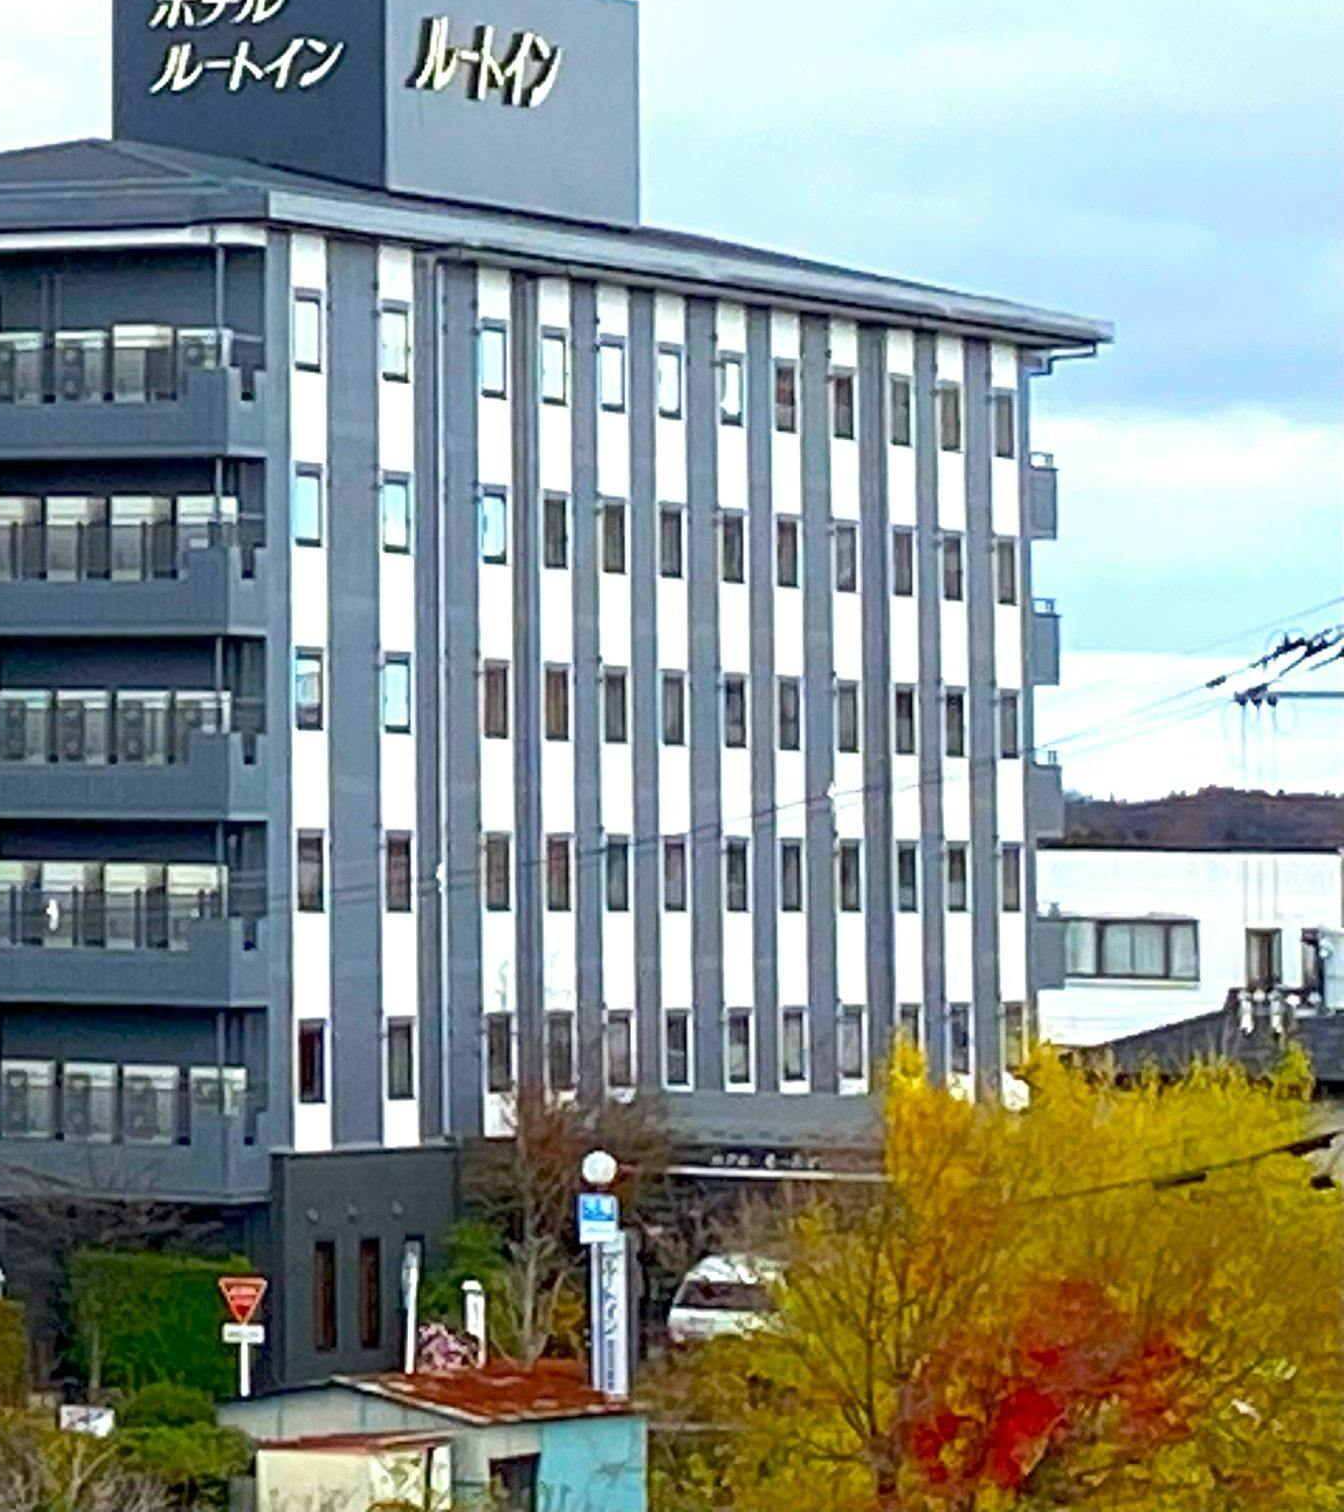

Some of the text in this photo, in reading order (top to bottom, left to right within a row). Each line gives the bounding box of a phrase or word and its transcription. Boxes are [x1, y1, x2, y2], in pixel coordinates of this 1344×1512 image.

[149, 38, 345, 94] ルートイン
[414, 15, 563, 108] ルートイン
